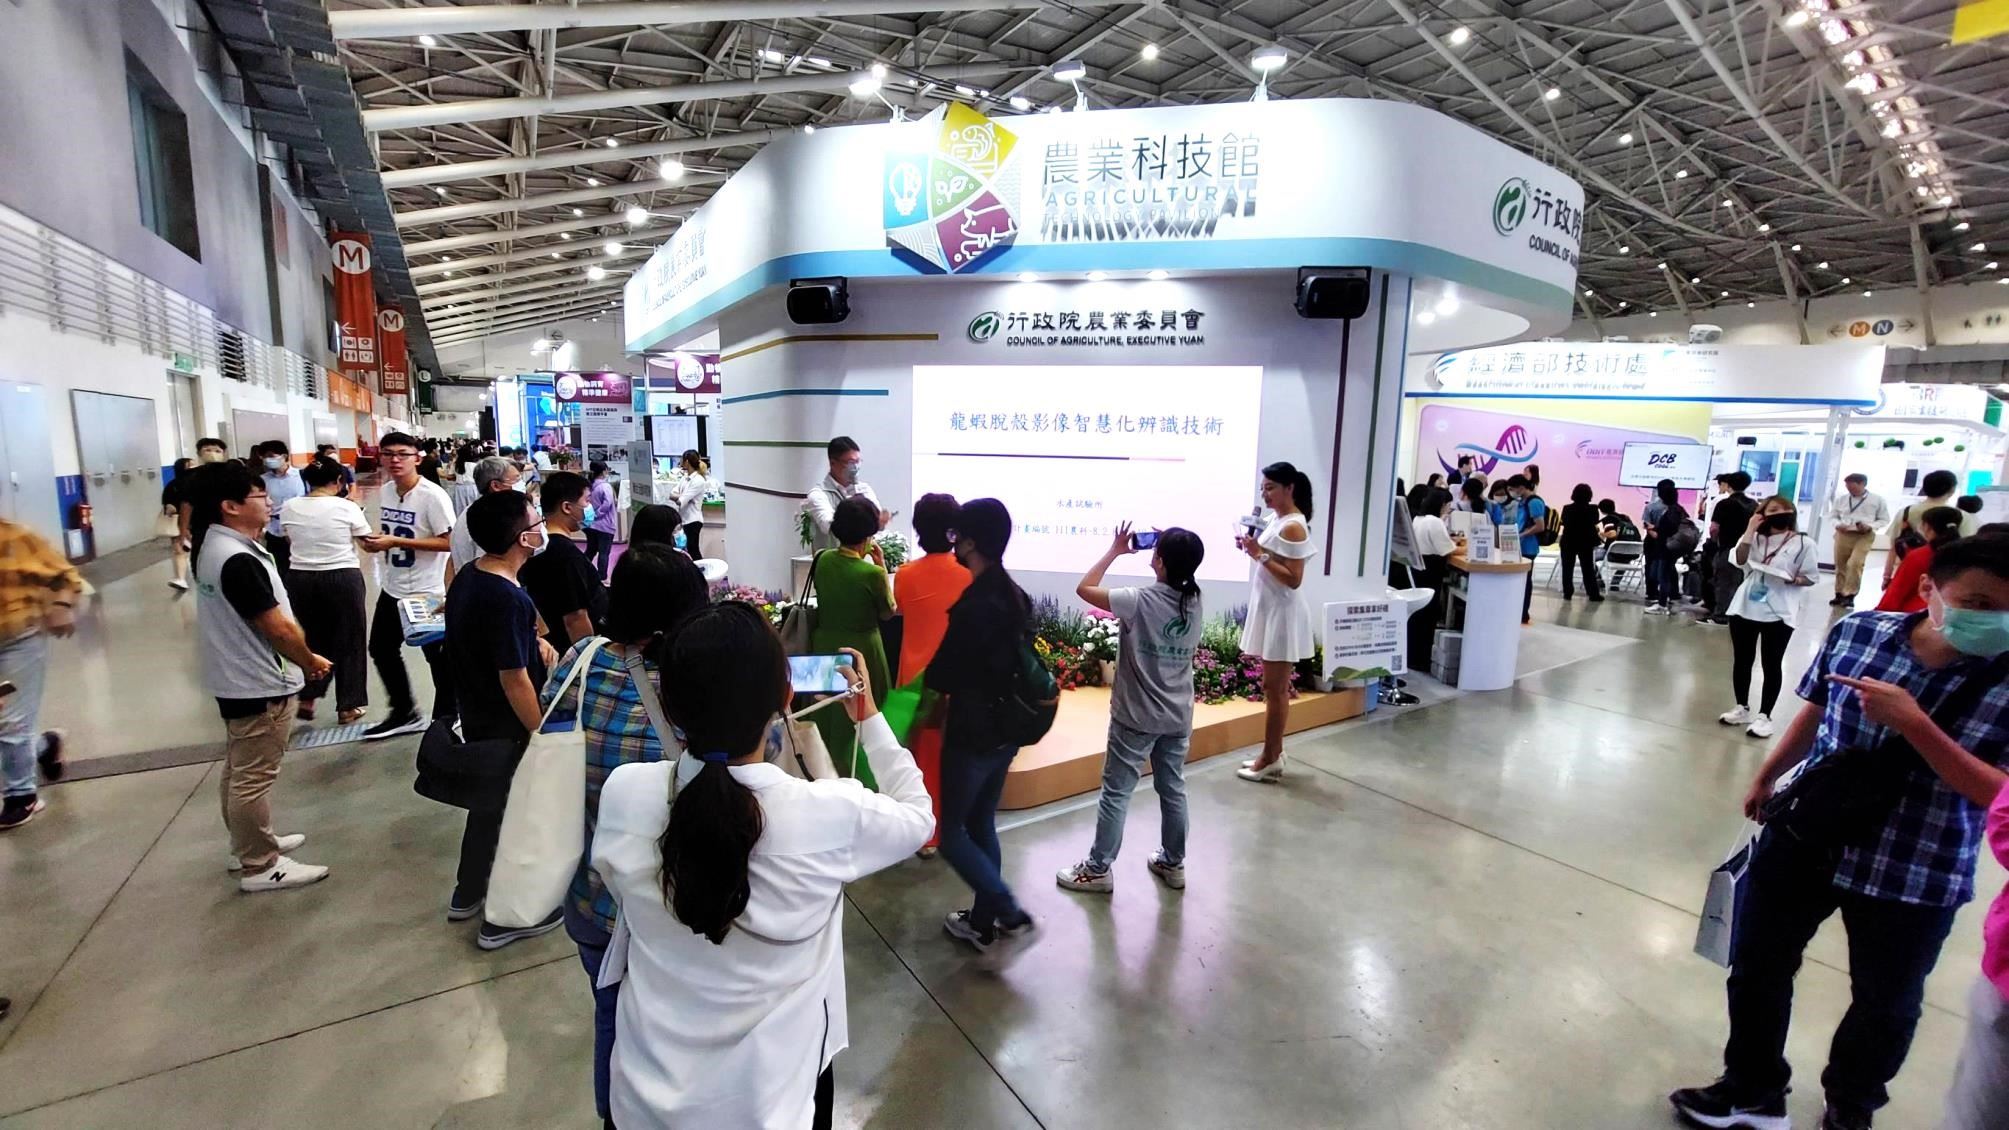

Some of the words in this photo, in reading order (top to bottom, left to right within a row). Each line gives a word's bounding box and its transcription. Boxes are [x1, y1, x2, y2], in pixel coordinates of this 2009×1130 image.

[1044, 132, 1260, 186] 農業科技館
[1045, 184, 1257, 207] AGRICULTURAL
[339, 244, 364, 270] M
[383, 313, 399, 329] M
[1006, 308, 1205, 332] 行政院農業委員會
[1876, 321, 1890, 334] N
[1853, 323, 1867, 335] M
[1006, 335, 1045, 346] COUNCIL
[1046, 335, 1059, 346] OF
[1060, 335, 1124, 347] AGRICULTURE,
[1126, 335, 1177, 346] EXECUTIVE
[1179, 335, 1205, 346] YUAN
[1648, 453, 1677, 466] DCB
